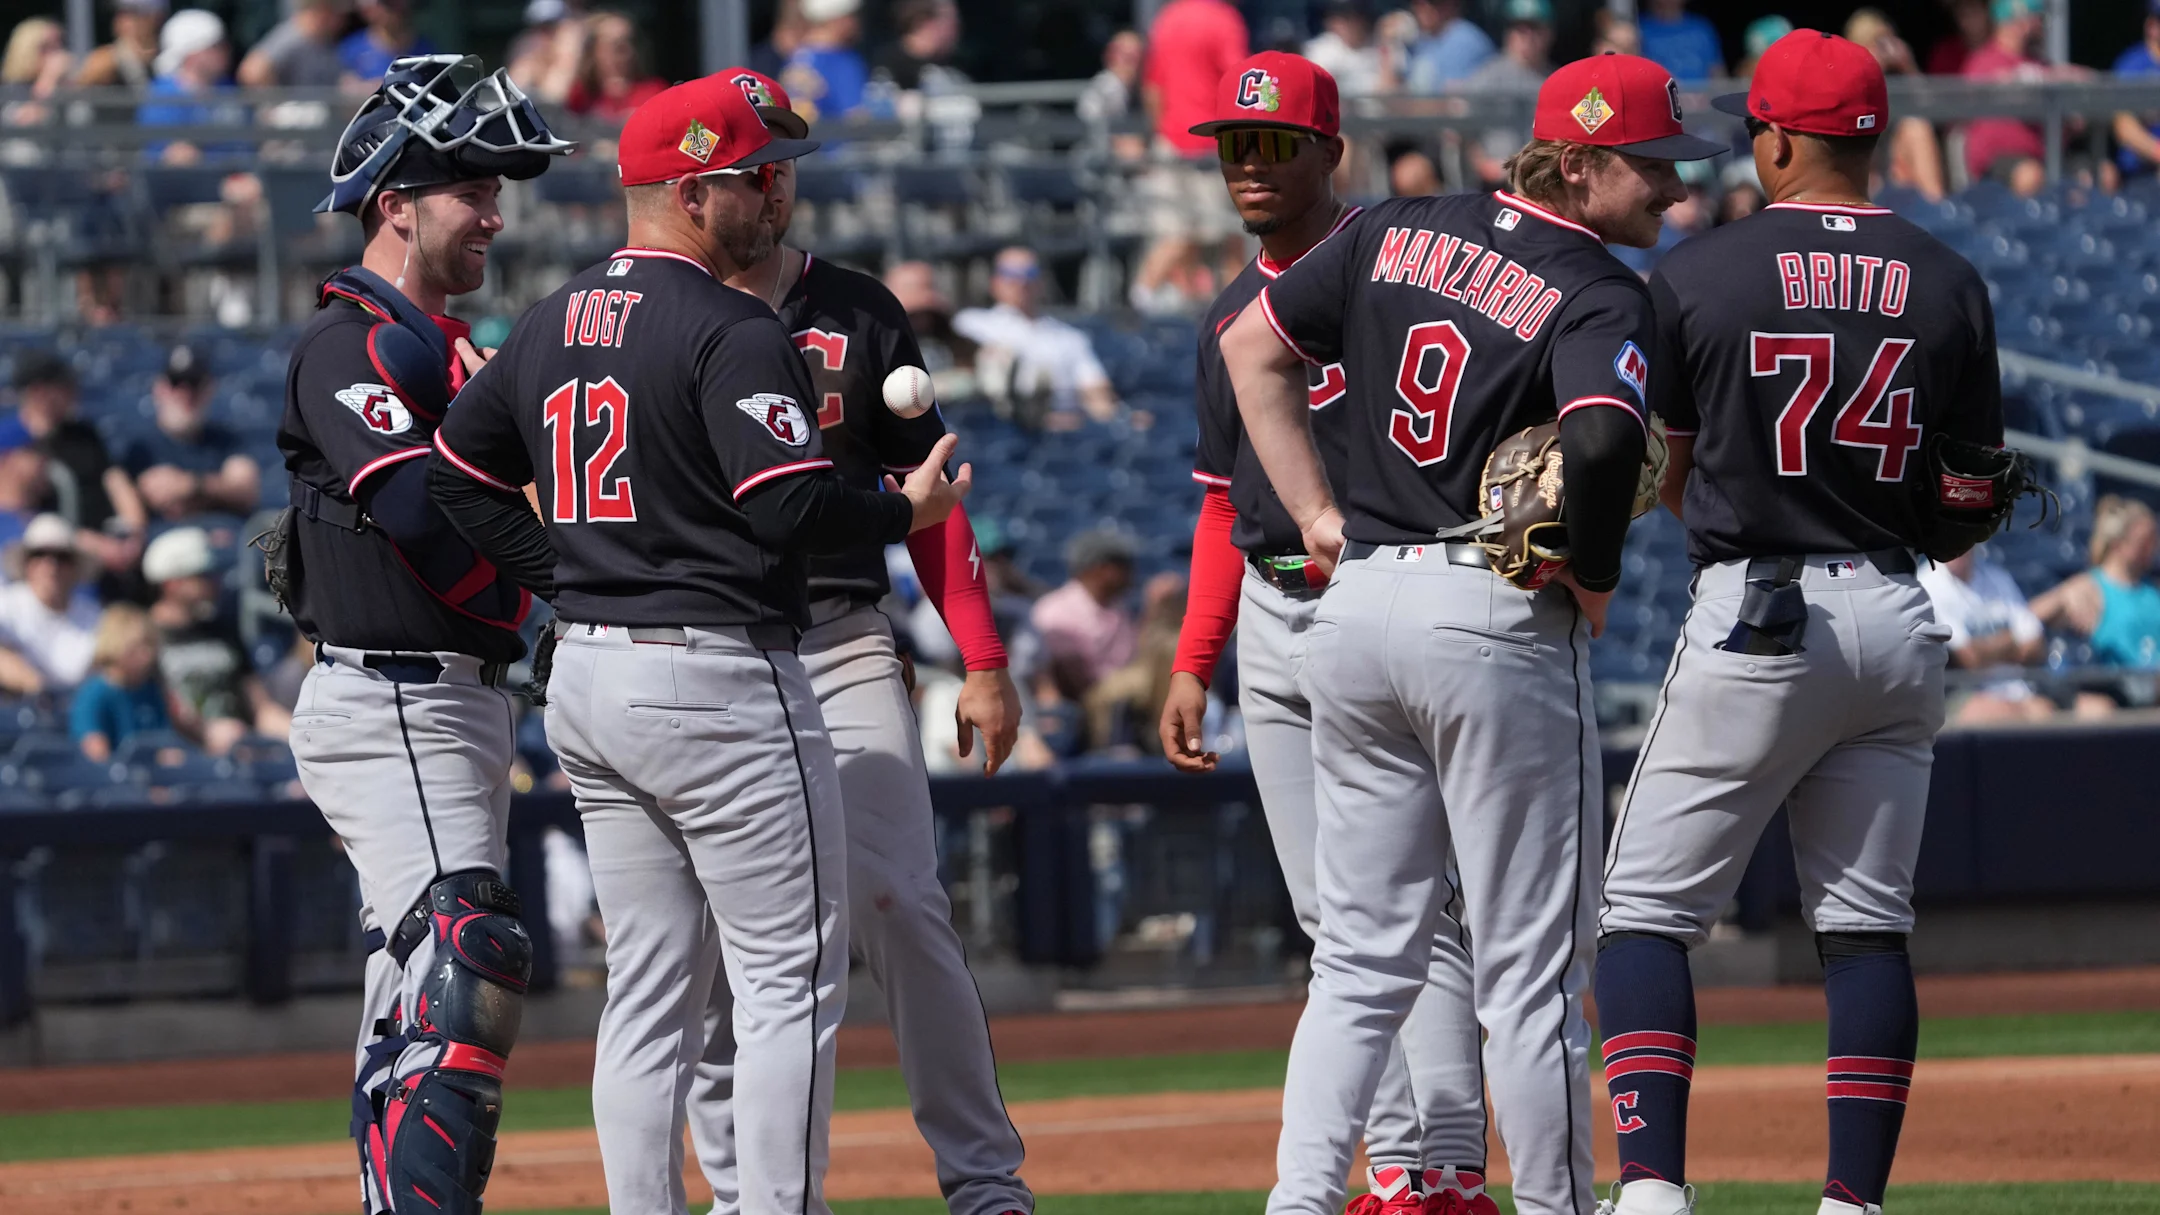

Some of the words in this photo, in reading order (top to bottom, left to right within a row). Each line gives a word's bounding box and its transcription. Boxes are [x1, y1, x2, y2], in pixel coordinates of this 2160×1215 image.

[1235, 68, 1267, 109] C
[1580, 100, 1604, 119] 26
[685, 128, 710, 152] 26
[1371, 227, 1562, 342] MANZARDO
[1776, 252, 1910, 318] BRITO
[564, 289, 643, 348] VOGT
[1388, 320, 1471, 467] 9
[1750, 331, 1923, 482] 74
[544, 375, 638, 523] 12
[1538, 451, 1563, 509] Rawlings
[1611, 1091, 1648, 1134] C
